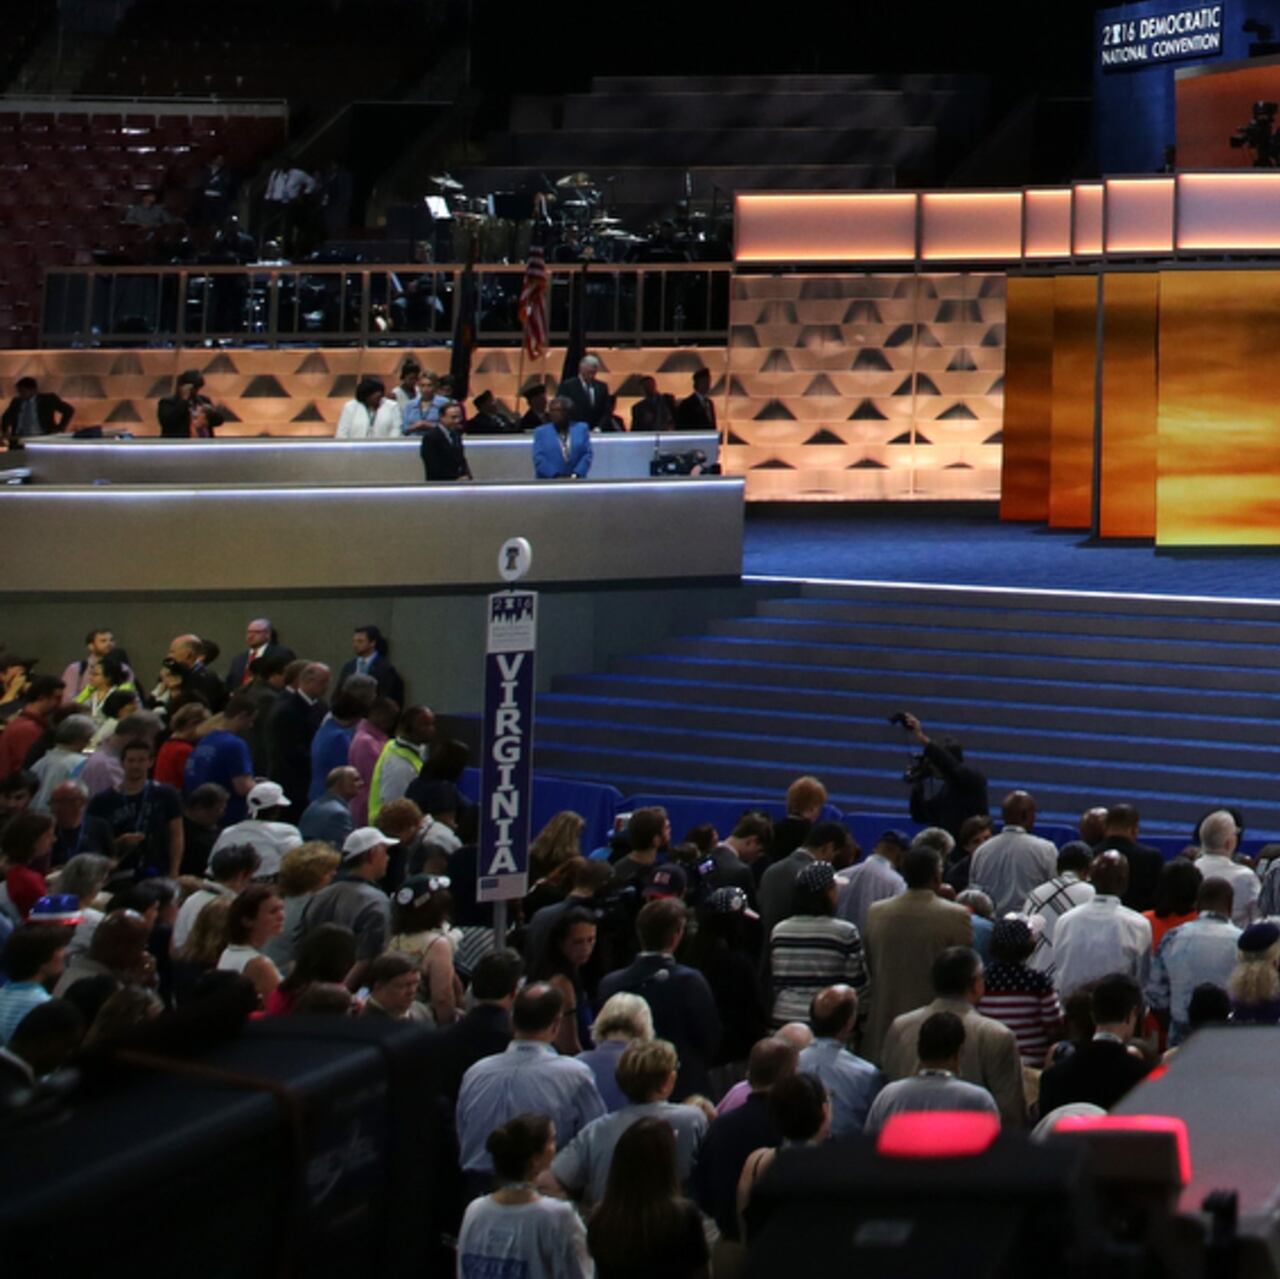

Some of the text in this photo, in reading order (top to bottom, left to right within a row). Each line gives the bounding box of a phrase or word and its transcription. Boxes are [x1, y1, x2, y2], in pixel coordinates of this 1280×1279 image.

[1140, 6, 1221, 39] DEMOCRATIC
[1102, 32, 1221, 65] NATIONAL CONVENTION
[488, 653, 525, 875] VIRGINIA
